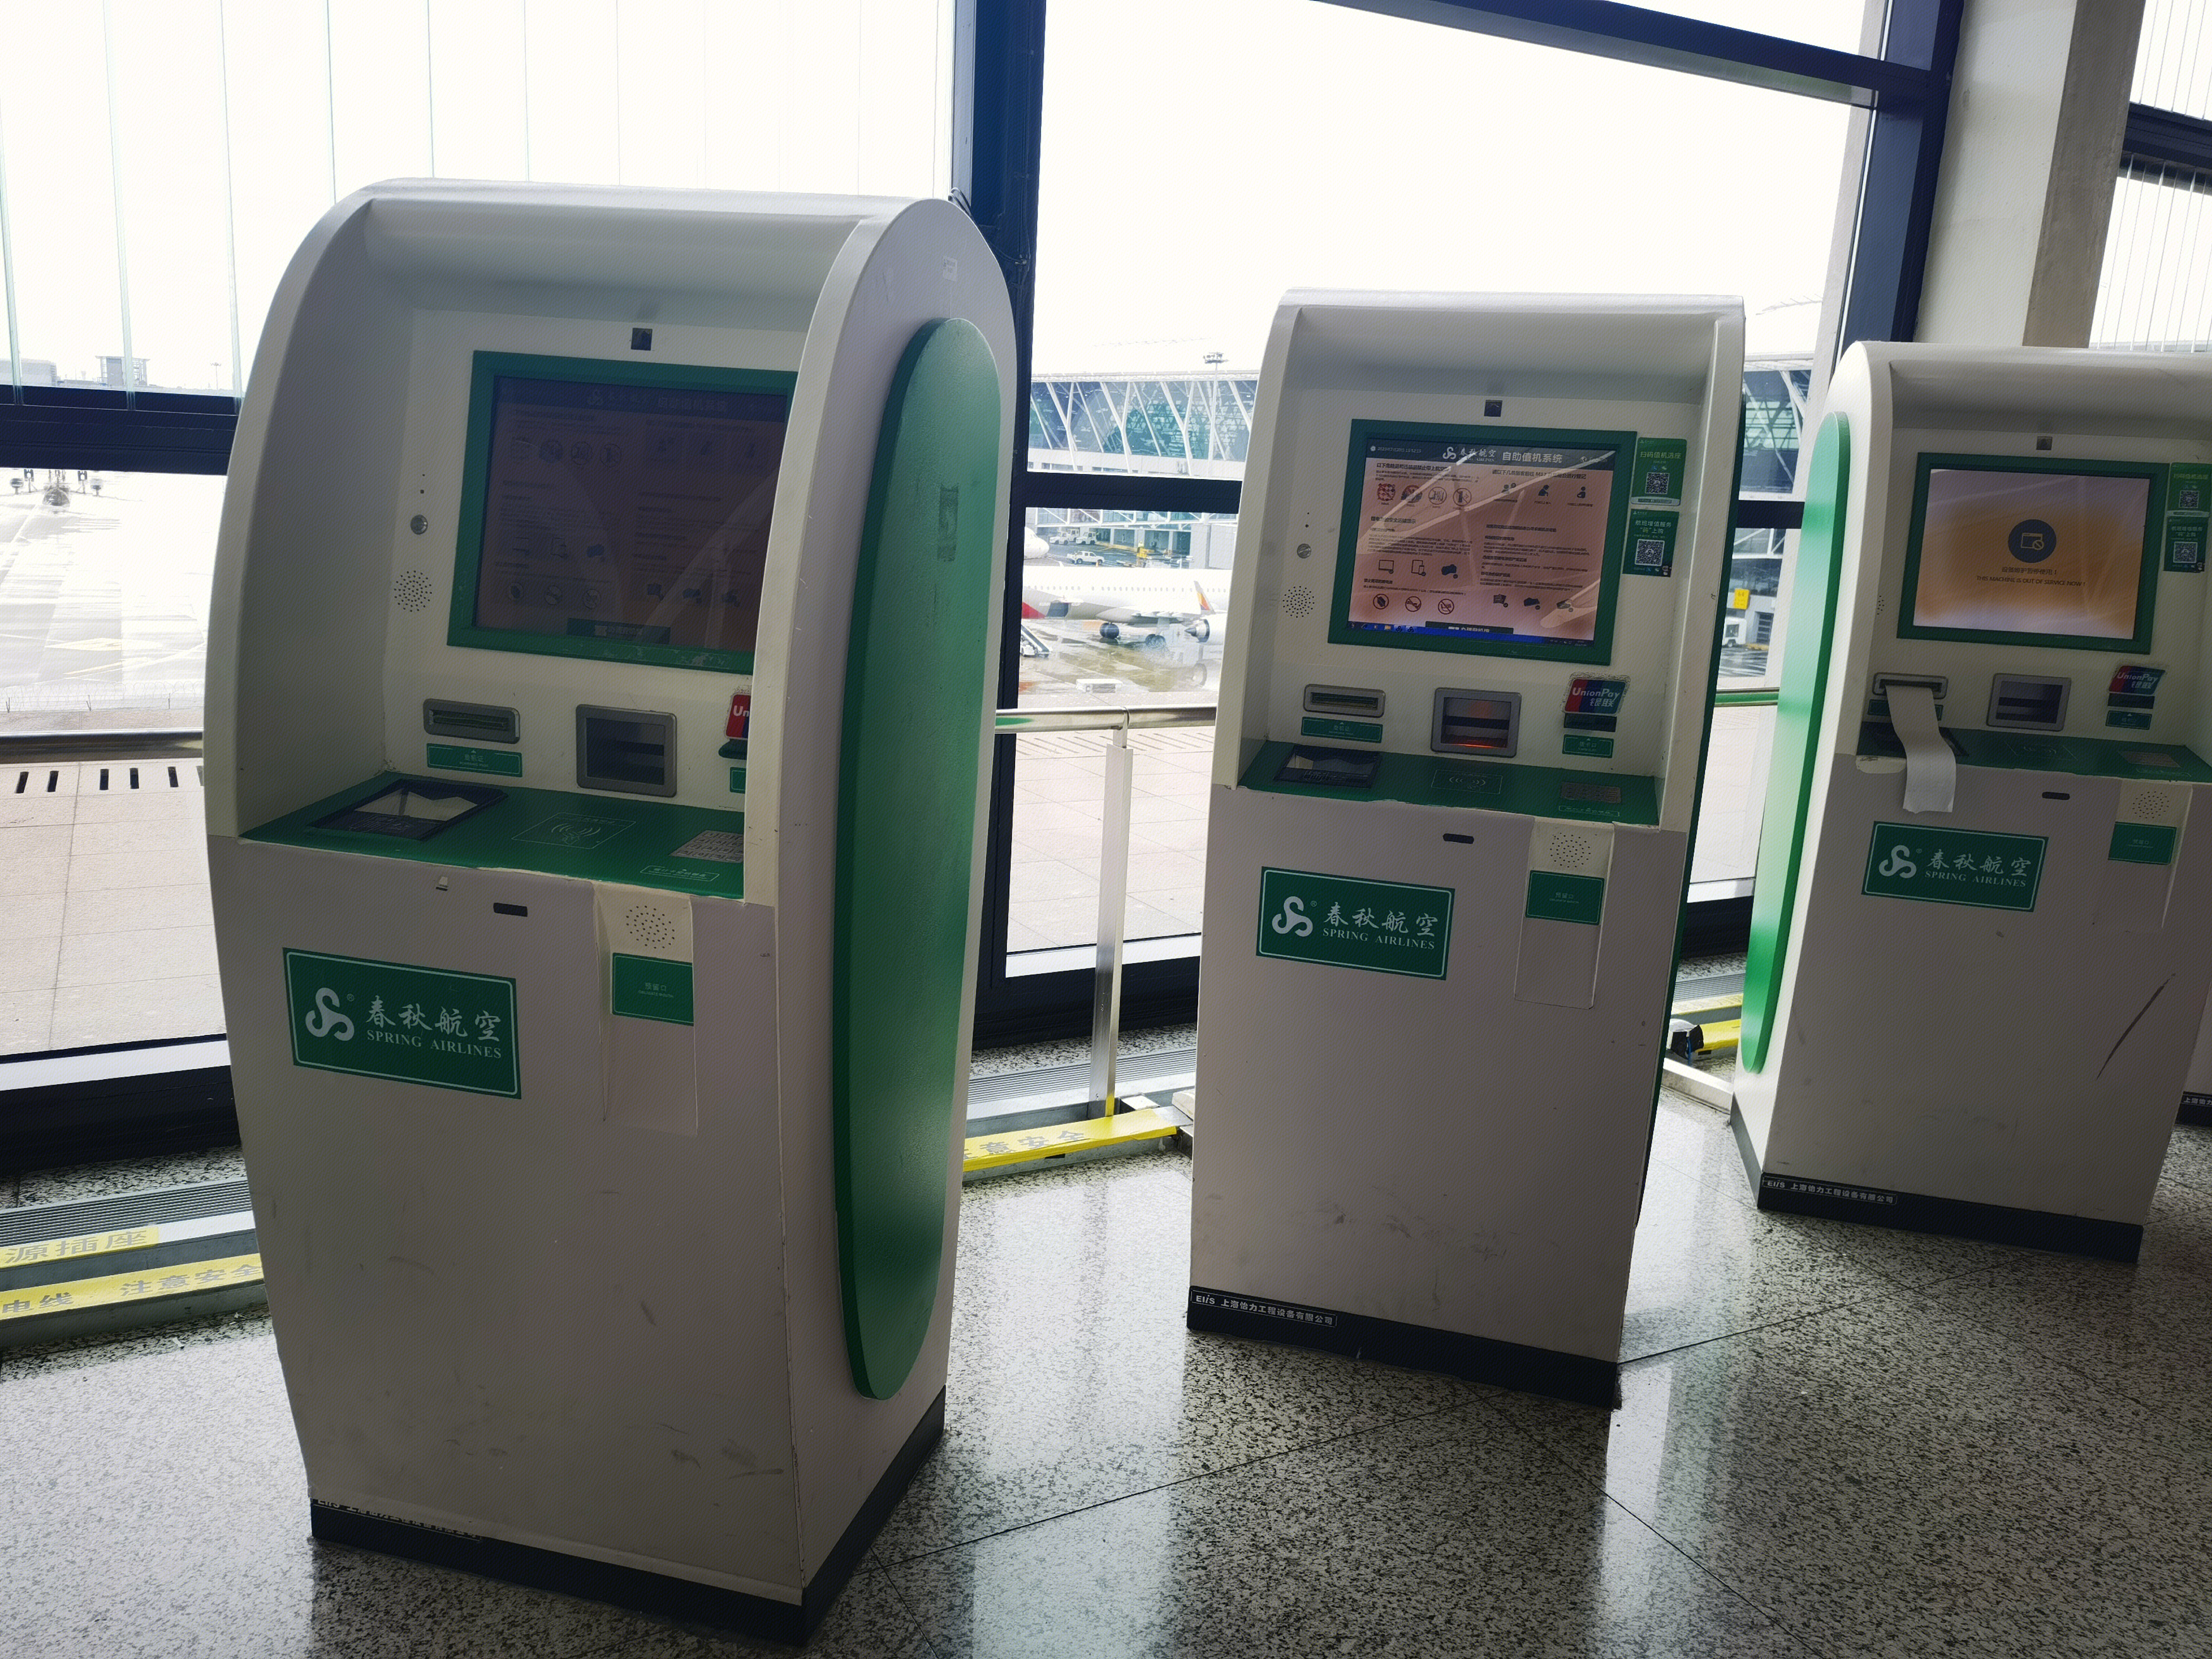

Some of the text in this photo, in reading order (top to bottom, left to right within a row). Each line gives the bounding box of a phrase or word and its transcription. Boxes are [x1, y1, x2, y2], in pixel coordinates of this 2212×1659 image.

[1502, 451, 1562, 463] 自助值机系统
[2117, 672, 2159, 685] UnionPay
[2131, 681, 2152, 689] 银联
[1572, 687, 1620, 702] UnionPay
[1590, 698, 1614, 707] 银联
[1926, 848, 2031, 877] 春秋航空
[1925, 870, 2027, 887] SPRING AIRLINES
[1323, 901, 1438, 937] 春秋航空
[1323, 928, 1435, 950] SPRING AIRLINES
[365, 995, 501, 1042] 春秋航空
[367, 1029, 502, 1058] SPRING AIRLINES
[1790, 1183, 1893, 1203] 上海怡力工程设备有限公司
[4, 1230, 147, 1264] 源插座
[2, 1264, 262, 1313] 电线 注意安全
[1220, 1298, 1333, 1325] 上海怡力工程设备有限公司
